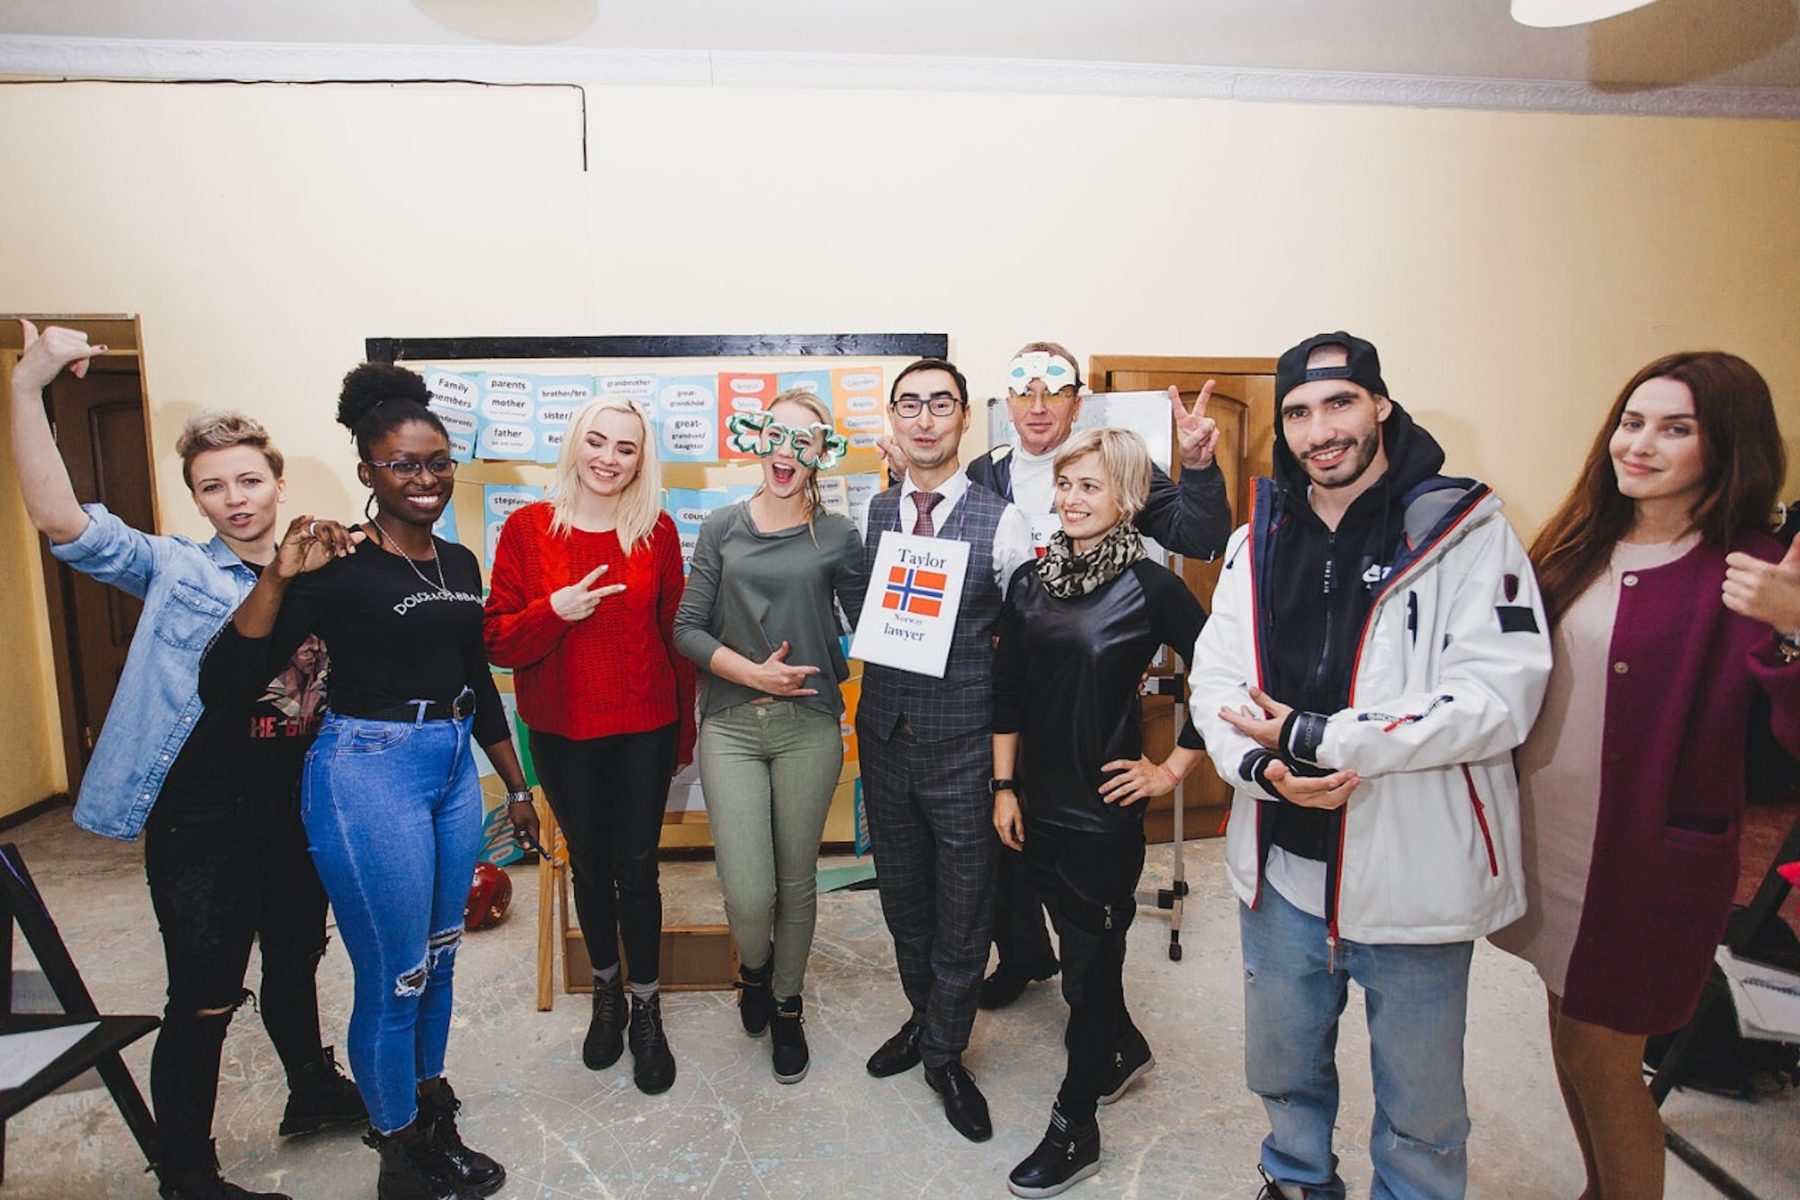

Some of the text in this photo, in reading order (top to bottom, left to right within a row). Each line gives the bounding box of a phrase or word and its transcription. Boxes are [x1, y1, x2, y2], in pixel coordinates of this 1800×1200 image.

[438, 378, 469, 394] Family
[491, 380, 526, 390] parents
[607, 379, 650, 388] grandmother
[541, 389, 587, 398] brother/bro
[491, 399, 525, 408] mother
[543, 411, 573, 420] sister/
[674, 420, 702, 429] great-
[494, 428, 522, 438] father
[673, 442, 704, 451] daughter
[897, 548, 947, 569] Taylor
[884, 622, 925, 641] lawyer
